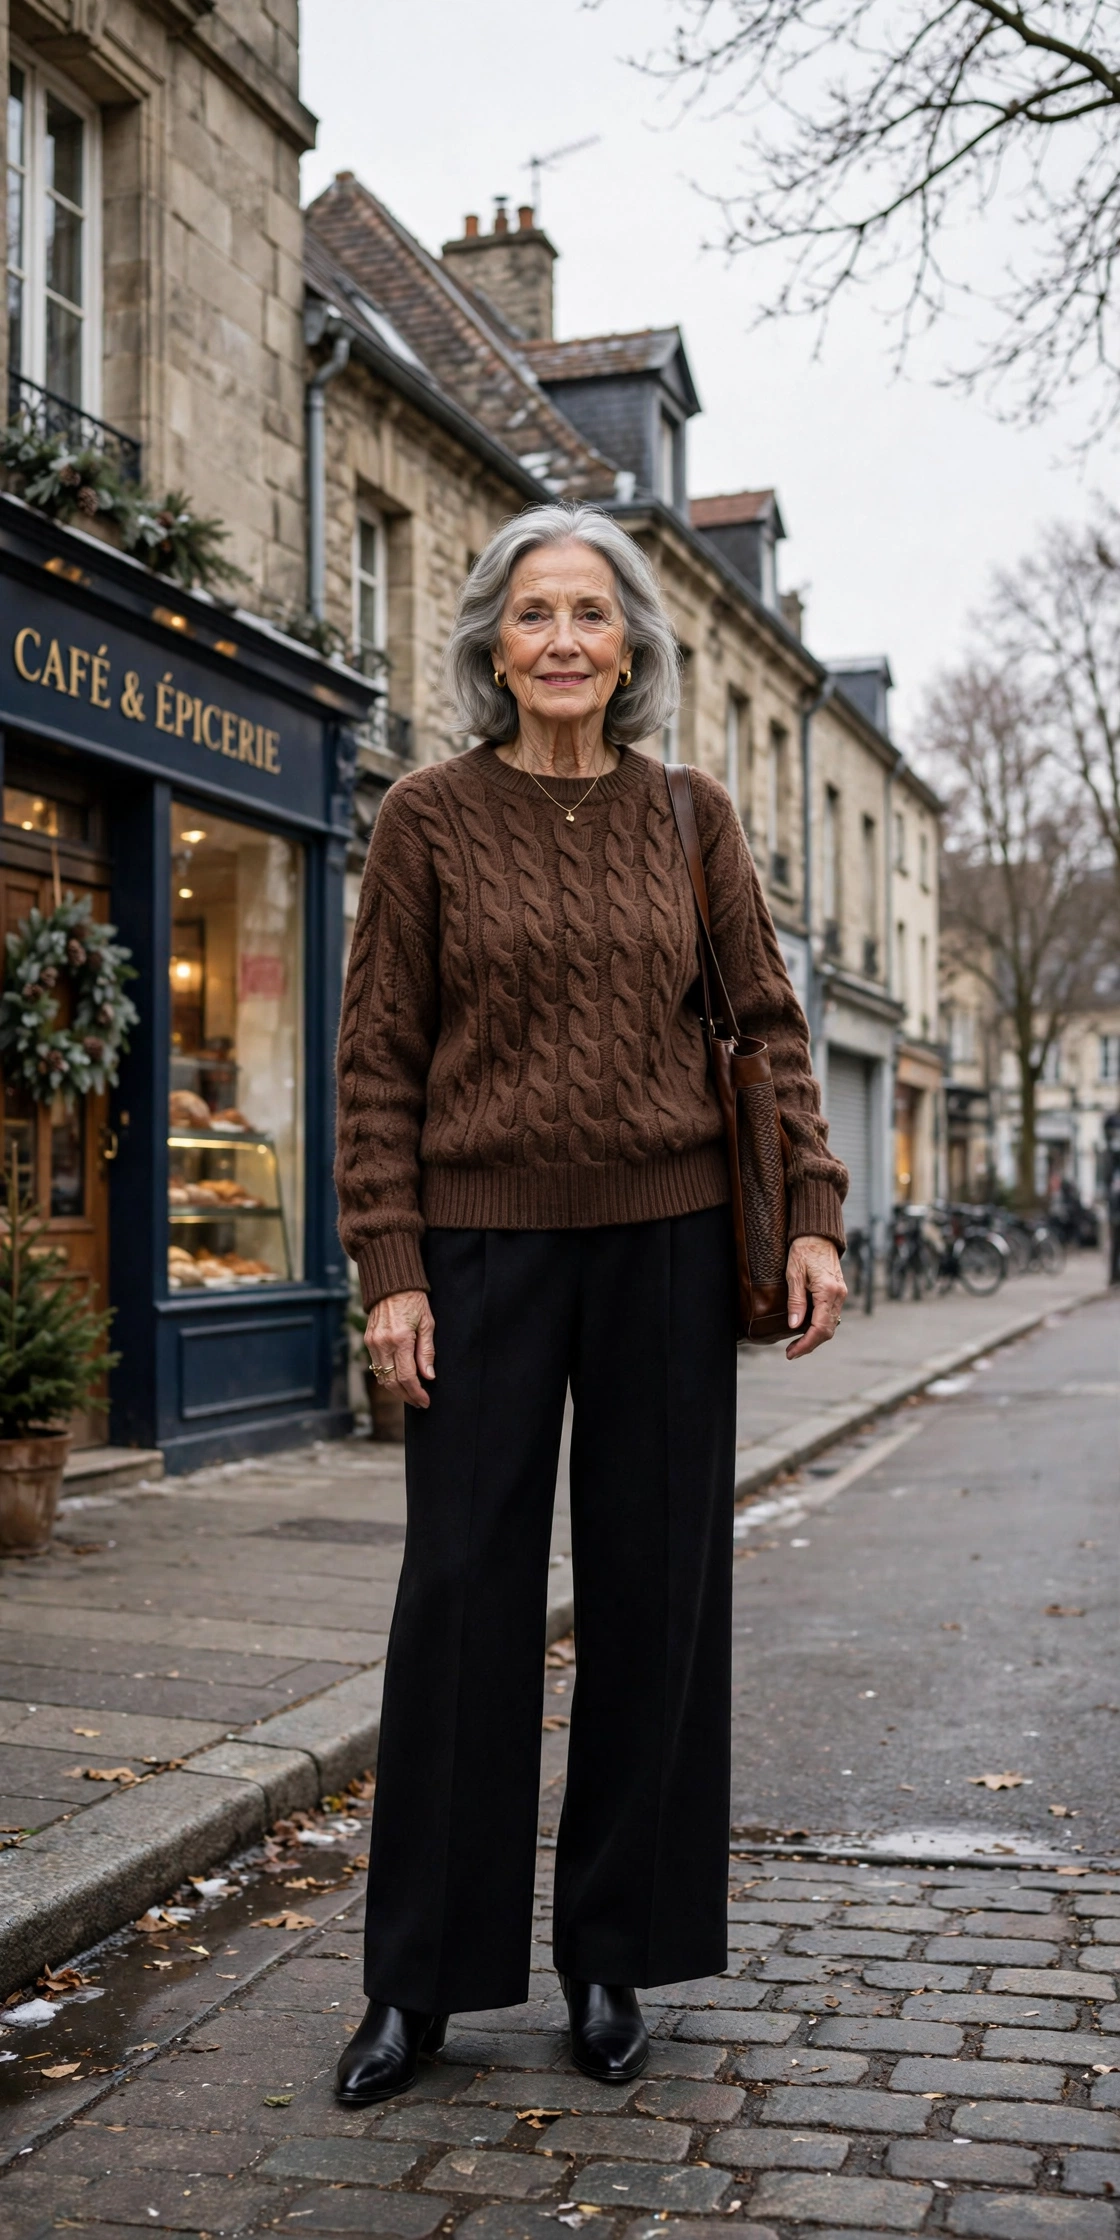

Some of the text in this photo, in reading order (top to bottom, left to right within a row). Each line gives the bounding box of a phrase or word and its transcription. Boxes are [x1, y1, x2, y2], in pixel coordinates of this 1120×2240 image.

[14, 627, 281, 775] CAFÉ & ÉPICERIE
